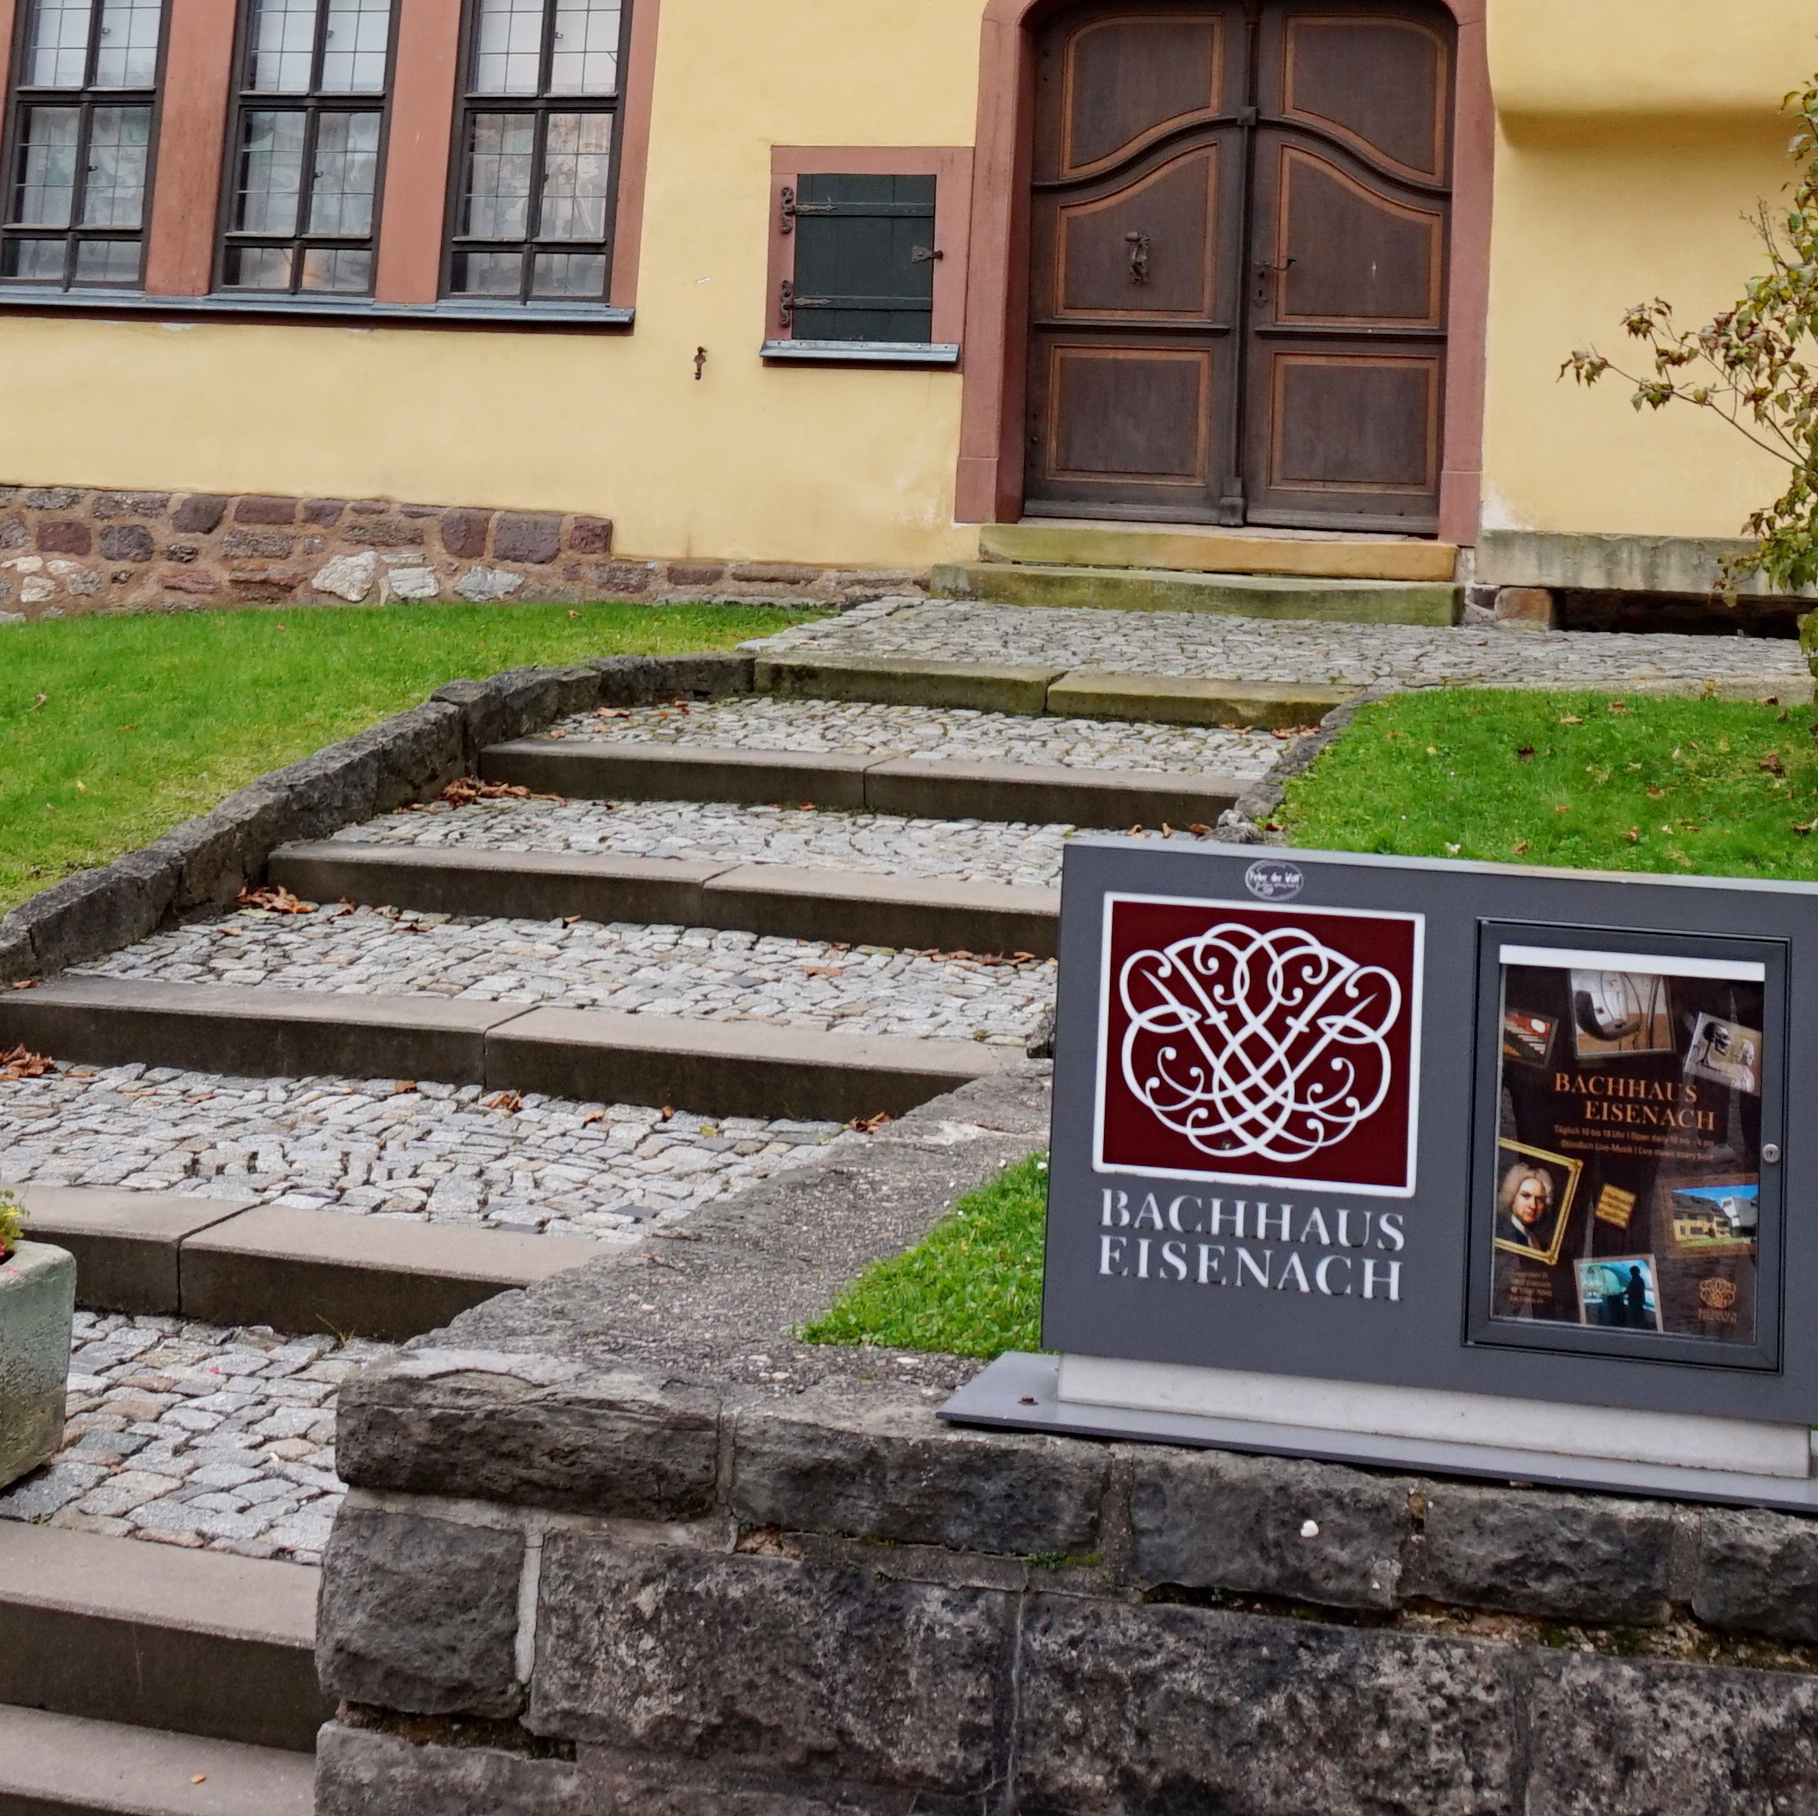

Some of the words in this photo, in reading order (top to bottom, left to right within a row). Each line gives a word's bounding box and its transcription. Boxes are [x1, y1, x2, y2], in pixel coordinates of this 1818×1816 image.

[1554, 1071, 1698, 1103] BACHHAUS
[1585, 1100, 1715, 1131] EISENACH
[1100, 1187, 1406, 1252] BACHHAUS
[1098, 1234, 1403, 1301] EISENACH
